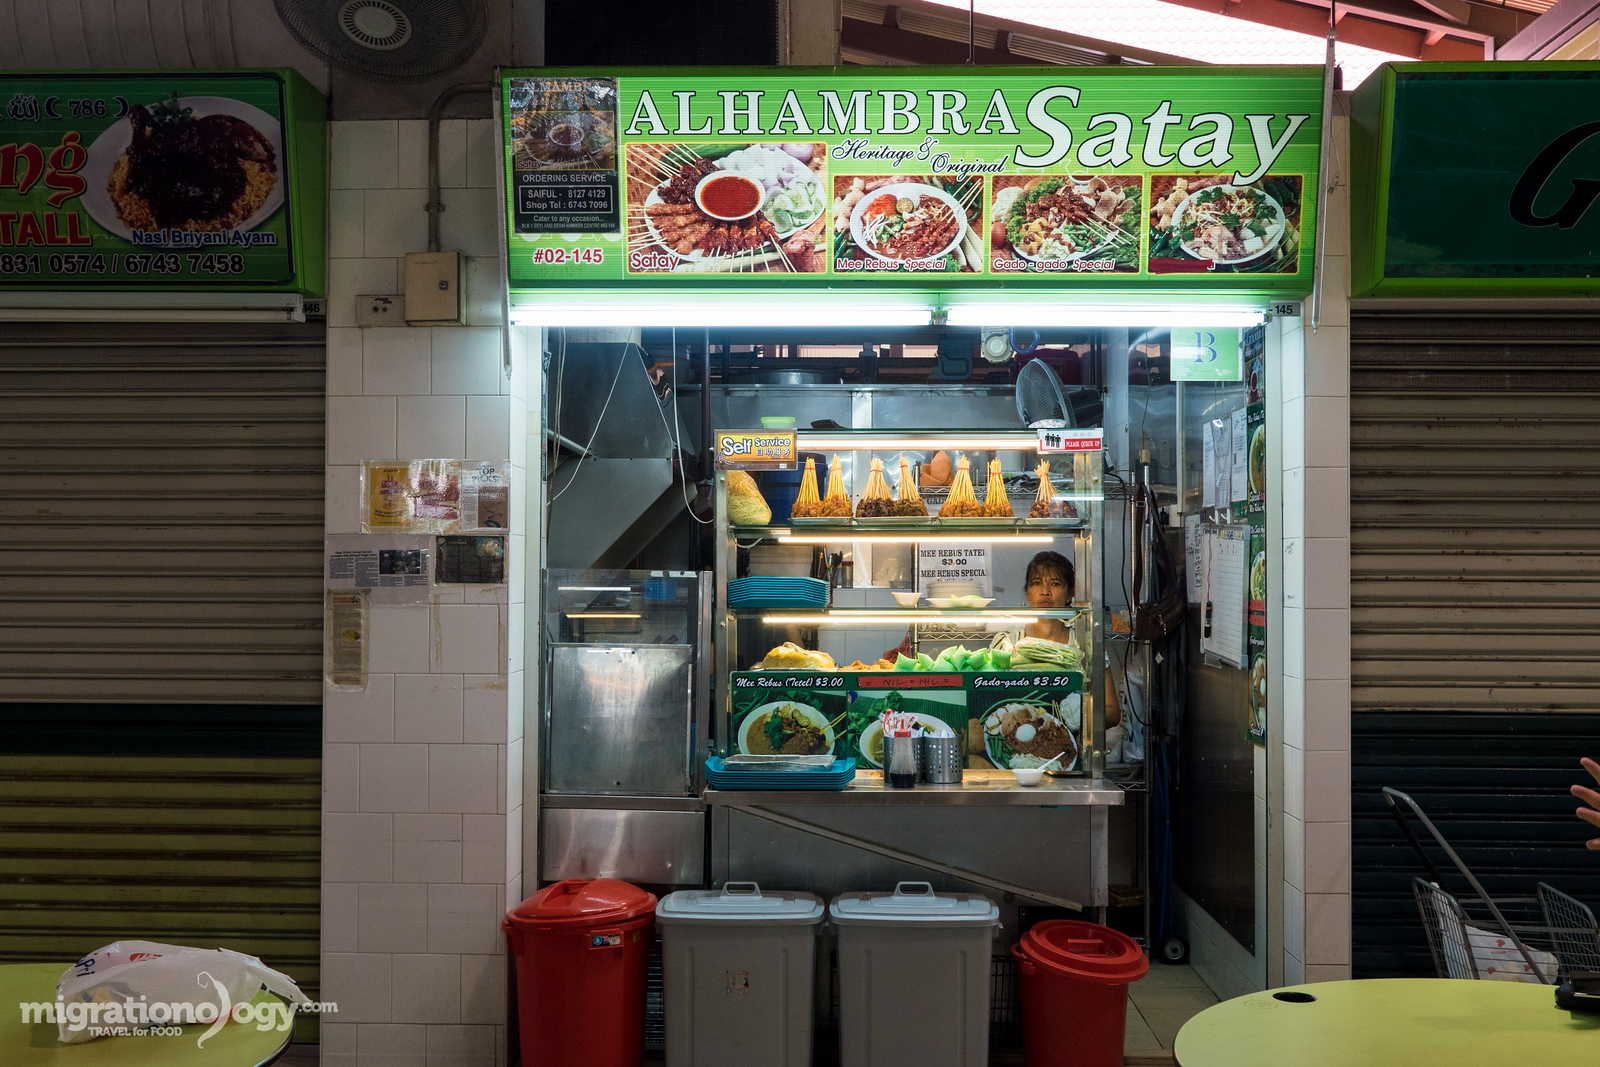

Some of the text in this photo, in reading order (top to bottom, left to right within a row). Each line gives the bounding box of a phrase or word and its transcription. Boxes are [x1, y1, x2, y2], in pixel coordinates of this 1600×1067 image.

[68, 99, 107, 117] 786
[624, 84, 1310, 188] ALHAMBRA Satay
[831, 136, 940, 168] Heritage &
[930, 152, 1011, 182] Original
[522, 173, 607, 183] ORDERING SERVICE
[1508, 120, 1600, 230] G
[528, 189, 557, 198] SAIFUL
[568, 189, 586, 198] 8127
[587, 189, 606, 198] 4129
[526, 201, 547, 210] Shop
[549, 201, 561, 209] Tel
[568, 201, 587, 209] 6743
[588, 201, 608, 209] 7096
[533, 215, 550, 223] Cater
[551, 215, 558, 223] to
[559, 216, 570, 224] any
[132, 229, 277, 248] Nasi Briyani Ayam
[533, 248, 604, 264] #02-145
[631, 252, 681, 272] Satay
[49, 254, 107, 273] 0574
[124, 254, 181, 273] 6743
[187, 254, 245, 273] 7458
[837, 258, 947, 271] Mee Rebus Special
[994, 258, 1027, 270] Gado
[1036, 258, 1067, 271] gado
[1073, 258, 1115, 271] Special
[1192, 331, 1218, 363] B
[722, 437, 791, 456] Self Service
[1081, 440, 1094, 448] QUEUE
[920, 549, 937, 557] MEE
[938, 549, 963, 557] REBUS
[942, 558, 967, 566] $3.00
[920, 570, 937, 578] MEE
[937, 569, 960, 577] REBUS
[736, 678, 756, 687] Mee
[757, 677, 783, 687] Rebus
[815, 677, 844, 687] $3.00
[973, 676, 1070, 689] Gado-gado $3.50
